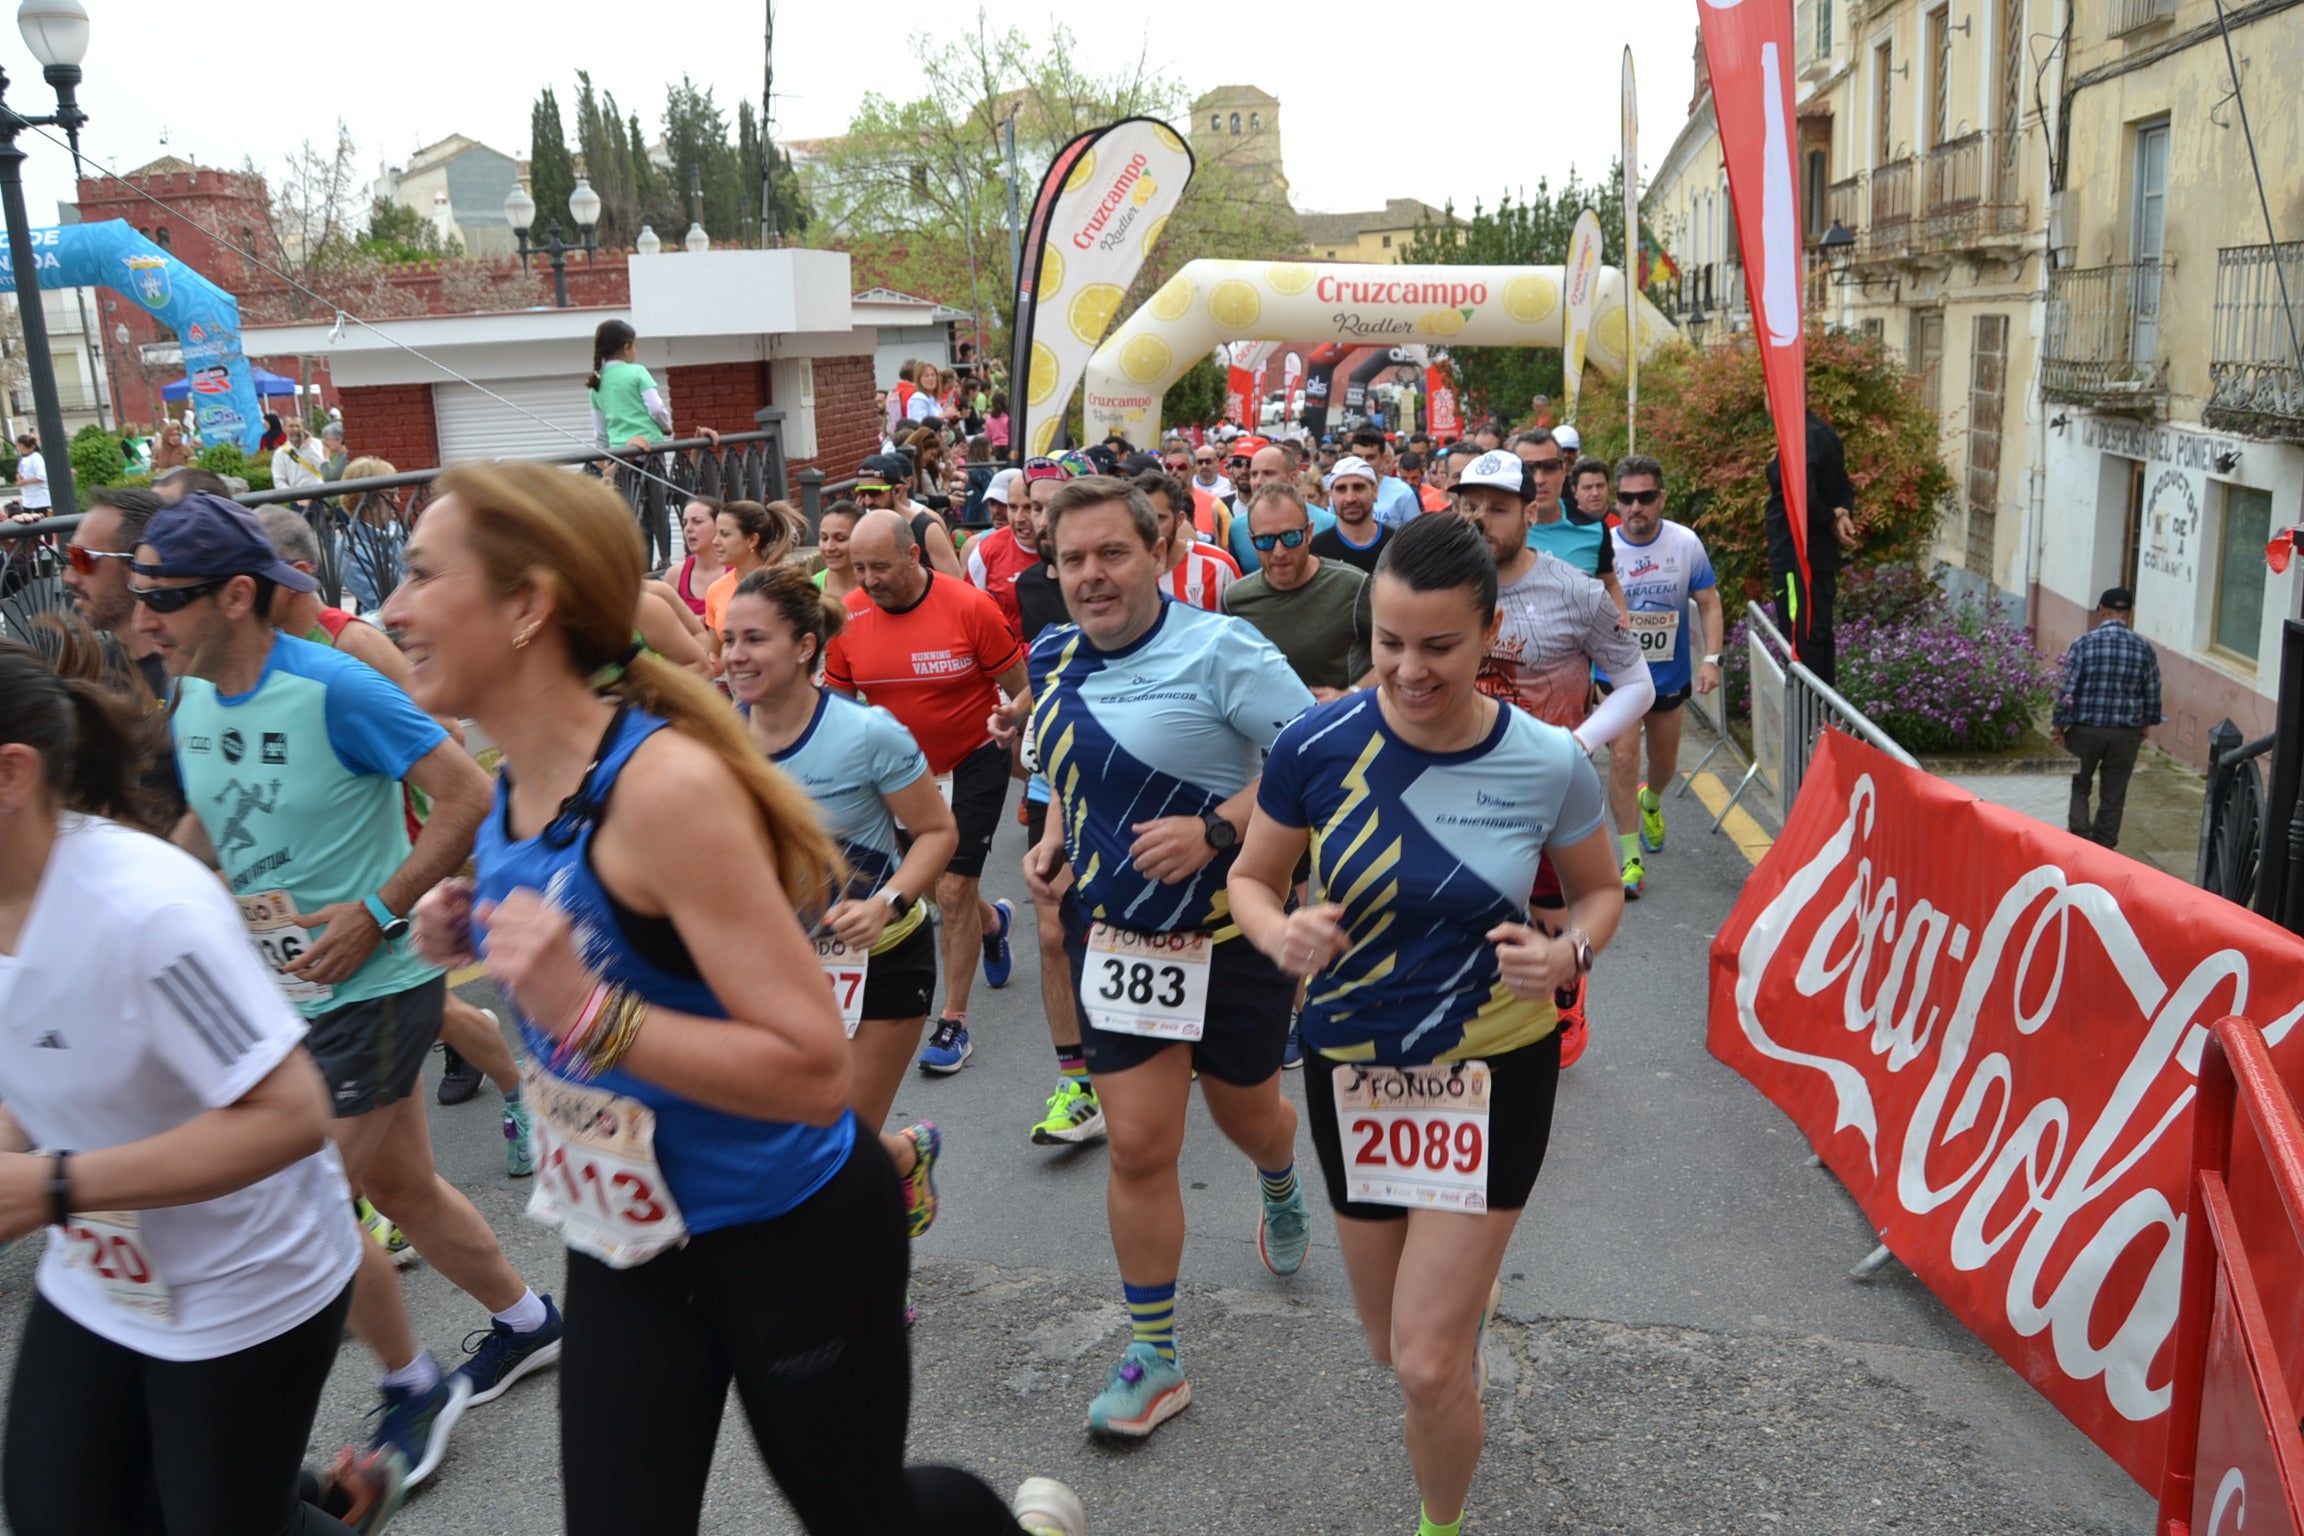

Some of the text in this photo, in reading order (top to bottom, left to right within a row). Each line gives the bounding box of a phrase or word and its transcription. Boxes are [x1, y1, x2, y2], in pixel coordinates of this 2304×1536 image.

[1073, 152, 1148, 250] Cruzcampo
[1100, 206, 1140, 253] Radler
[1317, 275, 1488, 309] Cruzcampo
[1332, 311, 1415, 337] Radler
[1088, 391, 1152, 409] Cruzcampo
[2150, 430, 2172, 463] DEL
[2172, 517, 2187, 537] DE
[1625, 583, 1678, 598] ARACENA
[1630, 614, 1667, 626] FONDO
[911, 650, 951, 662] RUNNING
[912, 656, 973, 675] VAMPIROS
[1100, 958, 1186, 1008] 383
[1372, 1075, 1465, 1098] FONDO
[1736, 773, 2250, 1421] Coca-Cola
[1351, 1117, 1483, 1177] 2089
